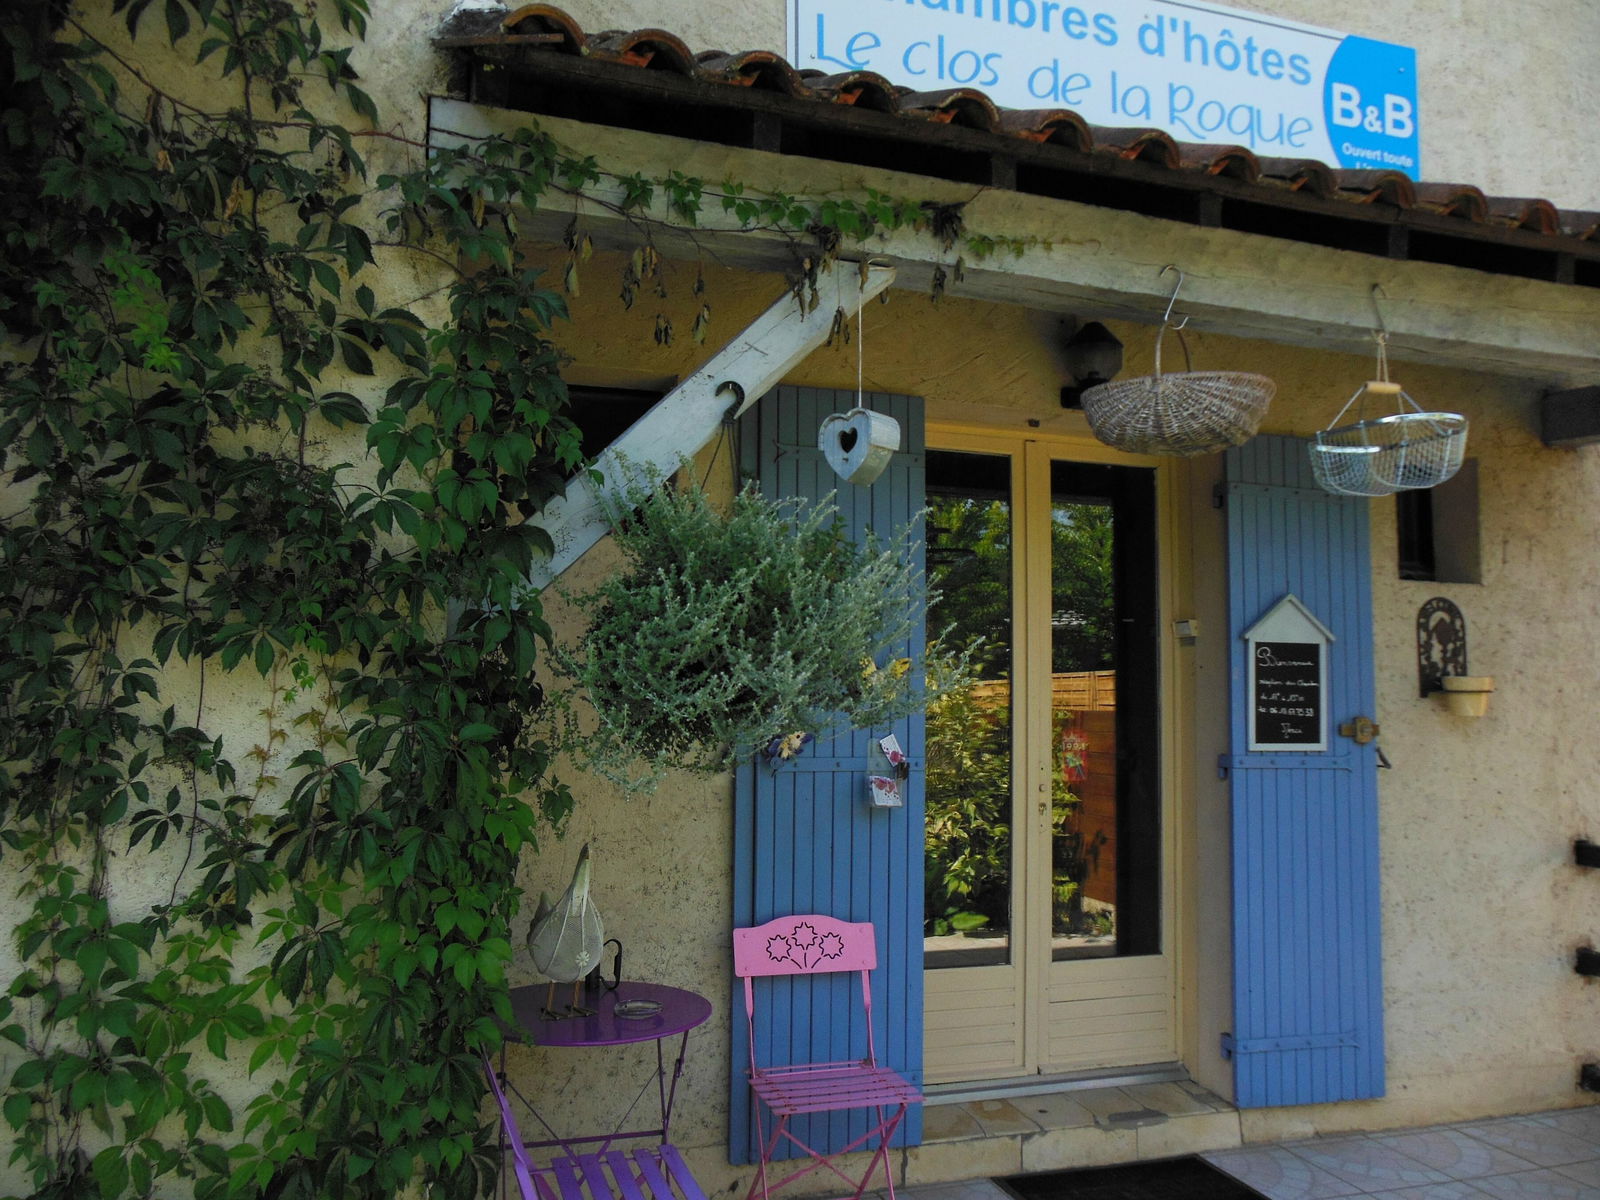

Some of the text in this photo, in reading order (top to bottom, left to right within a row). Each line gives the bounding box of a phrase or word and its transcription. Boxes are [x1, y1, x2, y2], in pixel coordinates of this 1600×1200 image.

[816, 12, 1313, 149] Le clos de la Roque
[1137, 14, 1312, 86] d'hôtes
[1332, 81, 1414, 139] B&B
[1341, 141, 1382, 162] Ouvert
